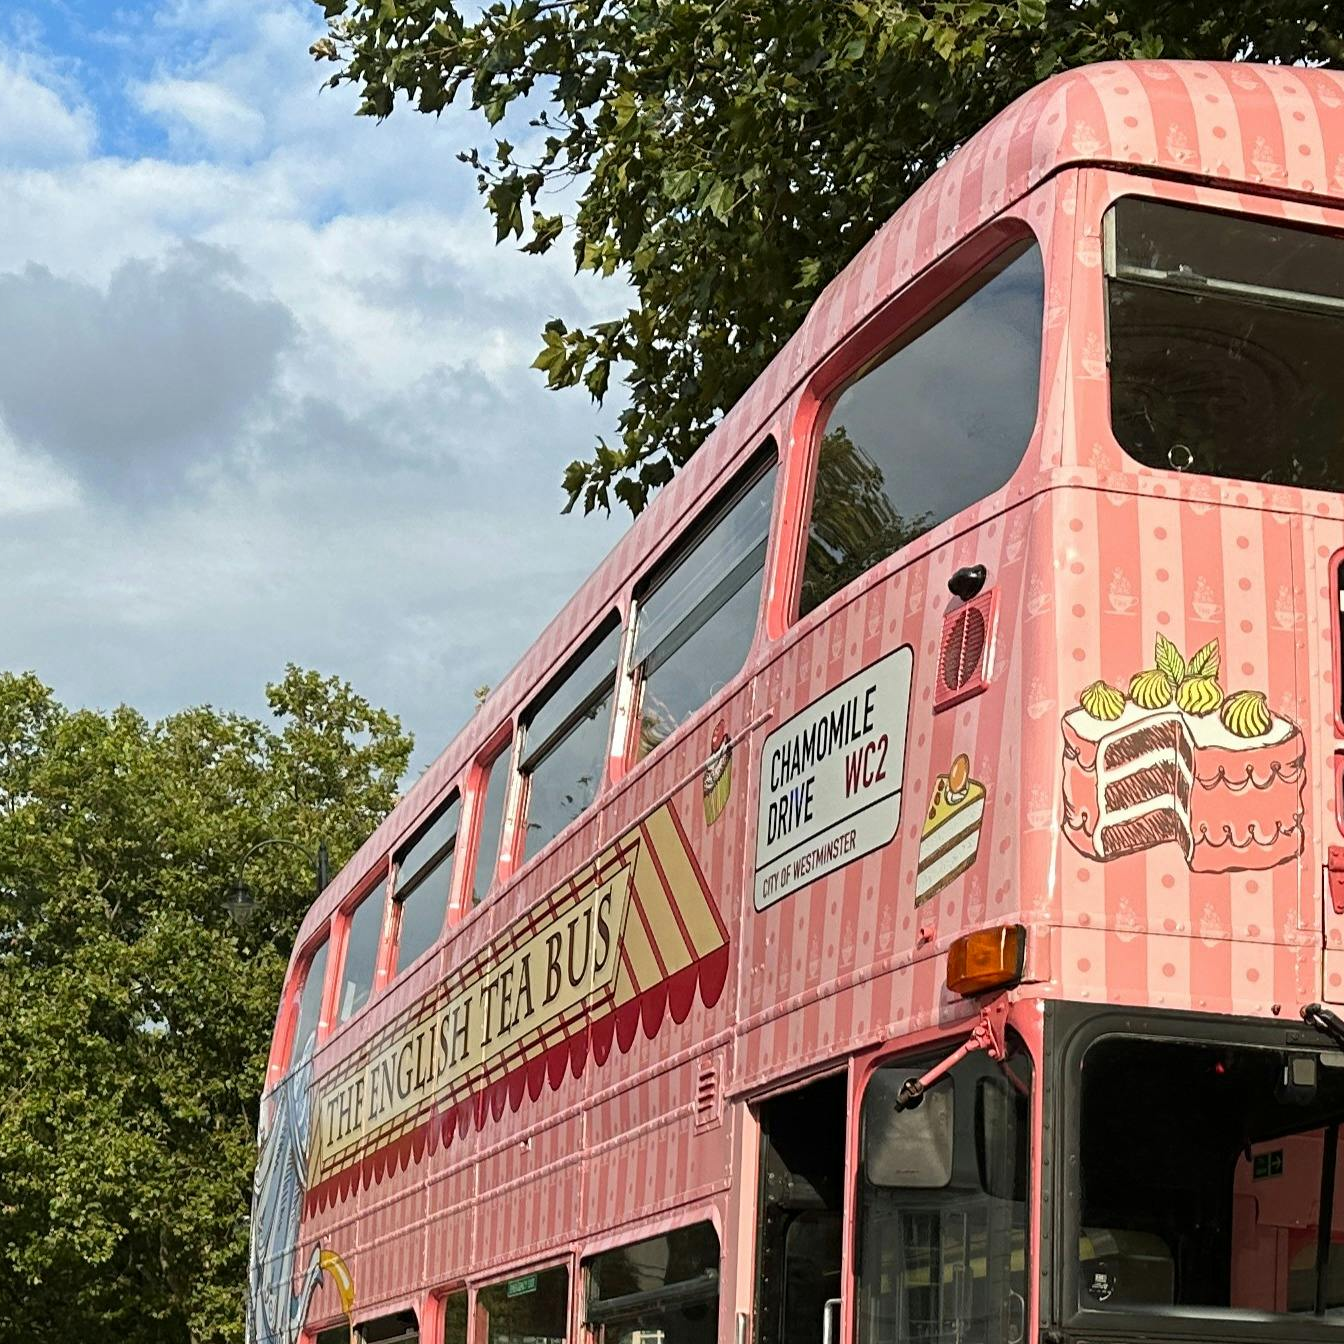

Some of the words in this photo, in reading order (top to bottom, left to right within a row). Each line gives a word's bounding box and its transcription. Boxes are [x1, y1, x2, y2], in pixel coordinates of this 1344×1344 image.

[770, 685, 877, 793] CHAMOMILE
[845, 734, 889, 799] WC2
[767, 776, 815, 847] DRIVE
[762, 873, 780, 898] CITY
[780, 870, 791, 889] OF
[793, 829, 857, 881] WESTMINSTER
[326, 1083, 365, 1147] THE
[367, 998, 473, 1121] ENGLISH
[480, 953, 536, 1048] TEA
[543, 891, 613, 1004] BUS
